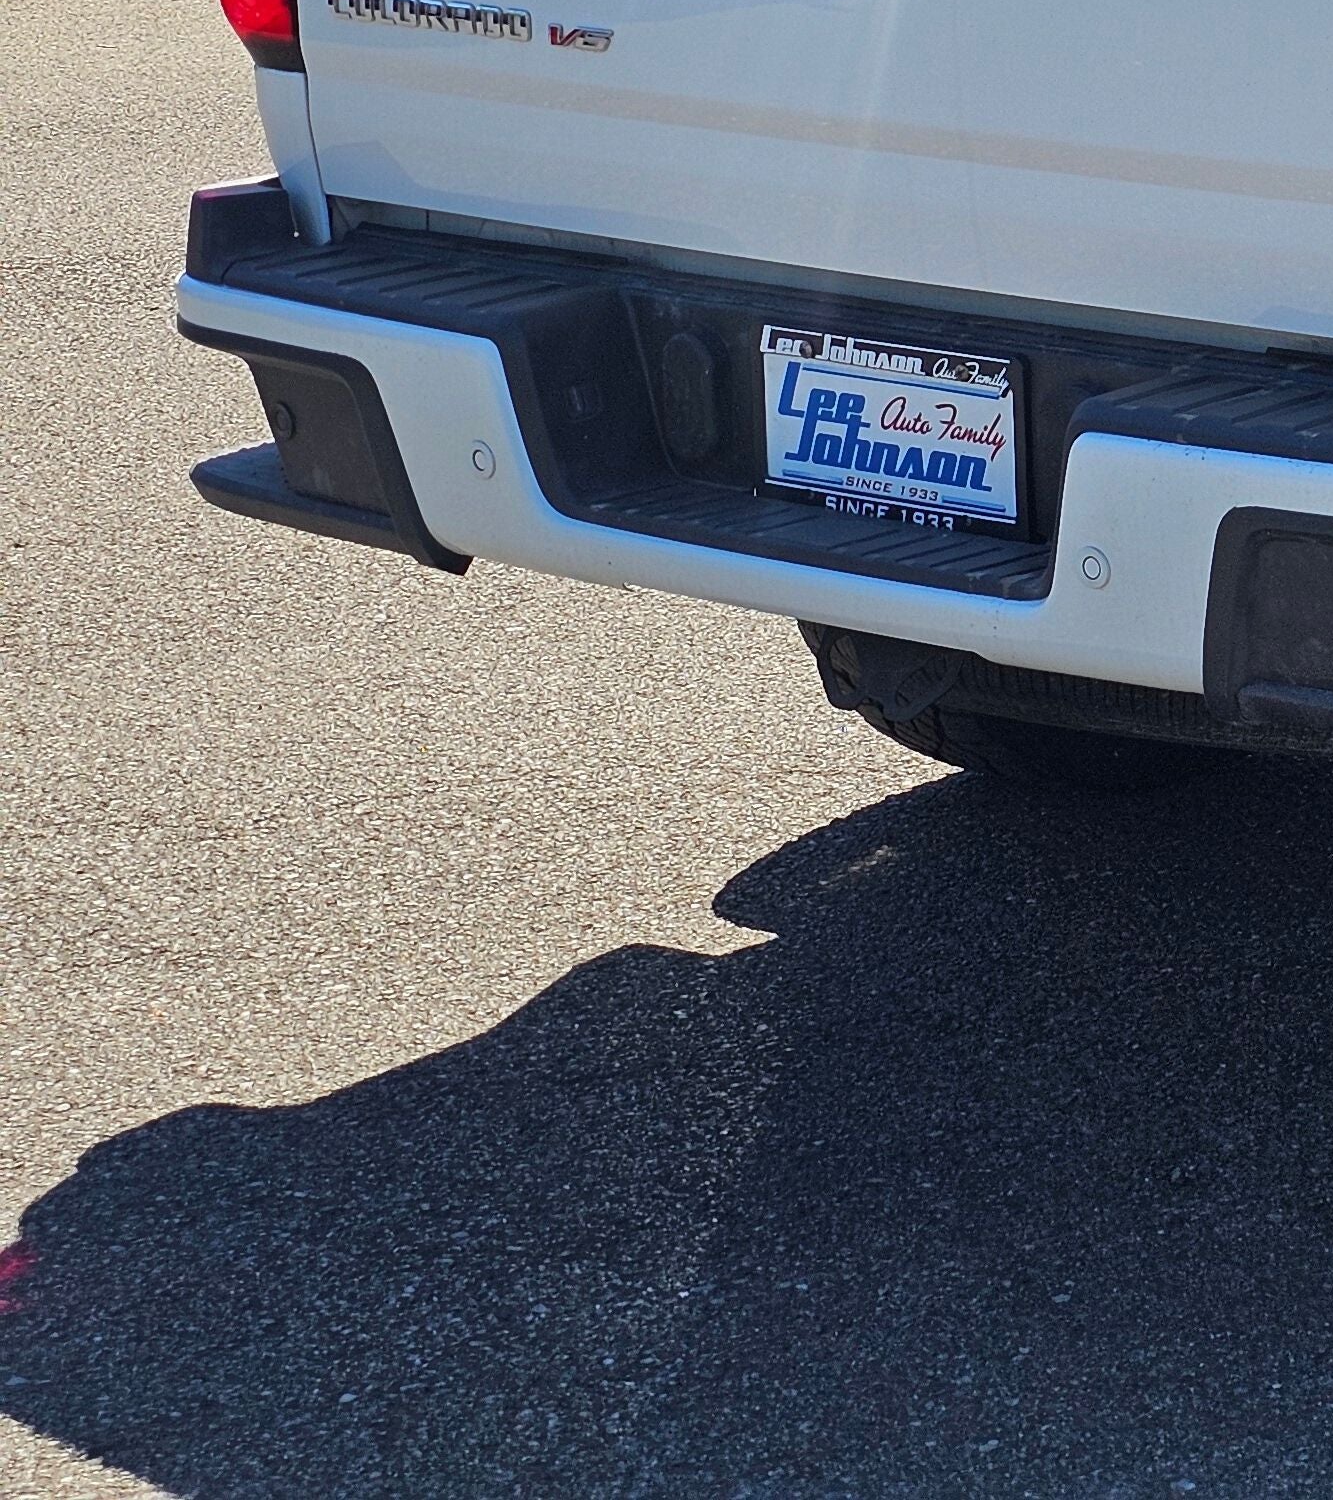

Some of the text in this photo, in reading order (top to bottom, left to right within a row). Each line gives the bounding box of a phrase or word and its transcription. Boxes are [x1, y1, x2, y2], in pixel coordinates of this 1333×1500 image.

[548, 23, 615, 52] V6
[778, 361, 866, 425] Lee
[815, 334, 926, 376] Johnson
[965, 361, 1010, 395] Family
[784, 415, 992, 492] Johnson
[880, 396, 1007, 461] Auto Family
[845, 476, 939, 502] SINCE 1933
